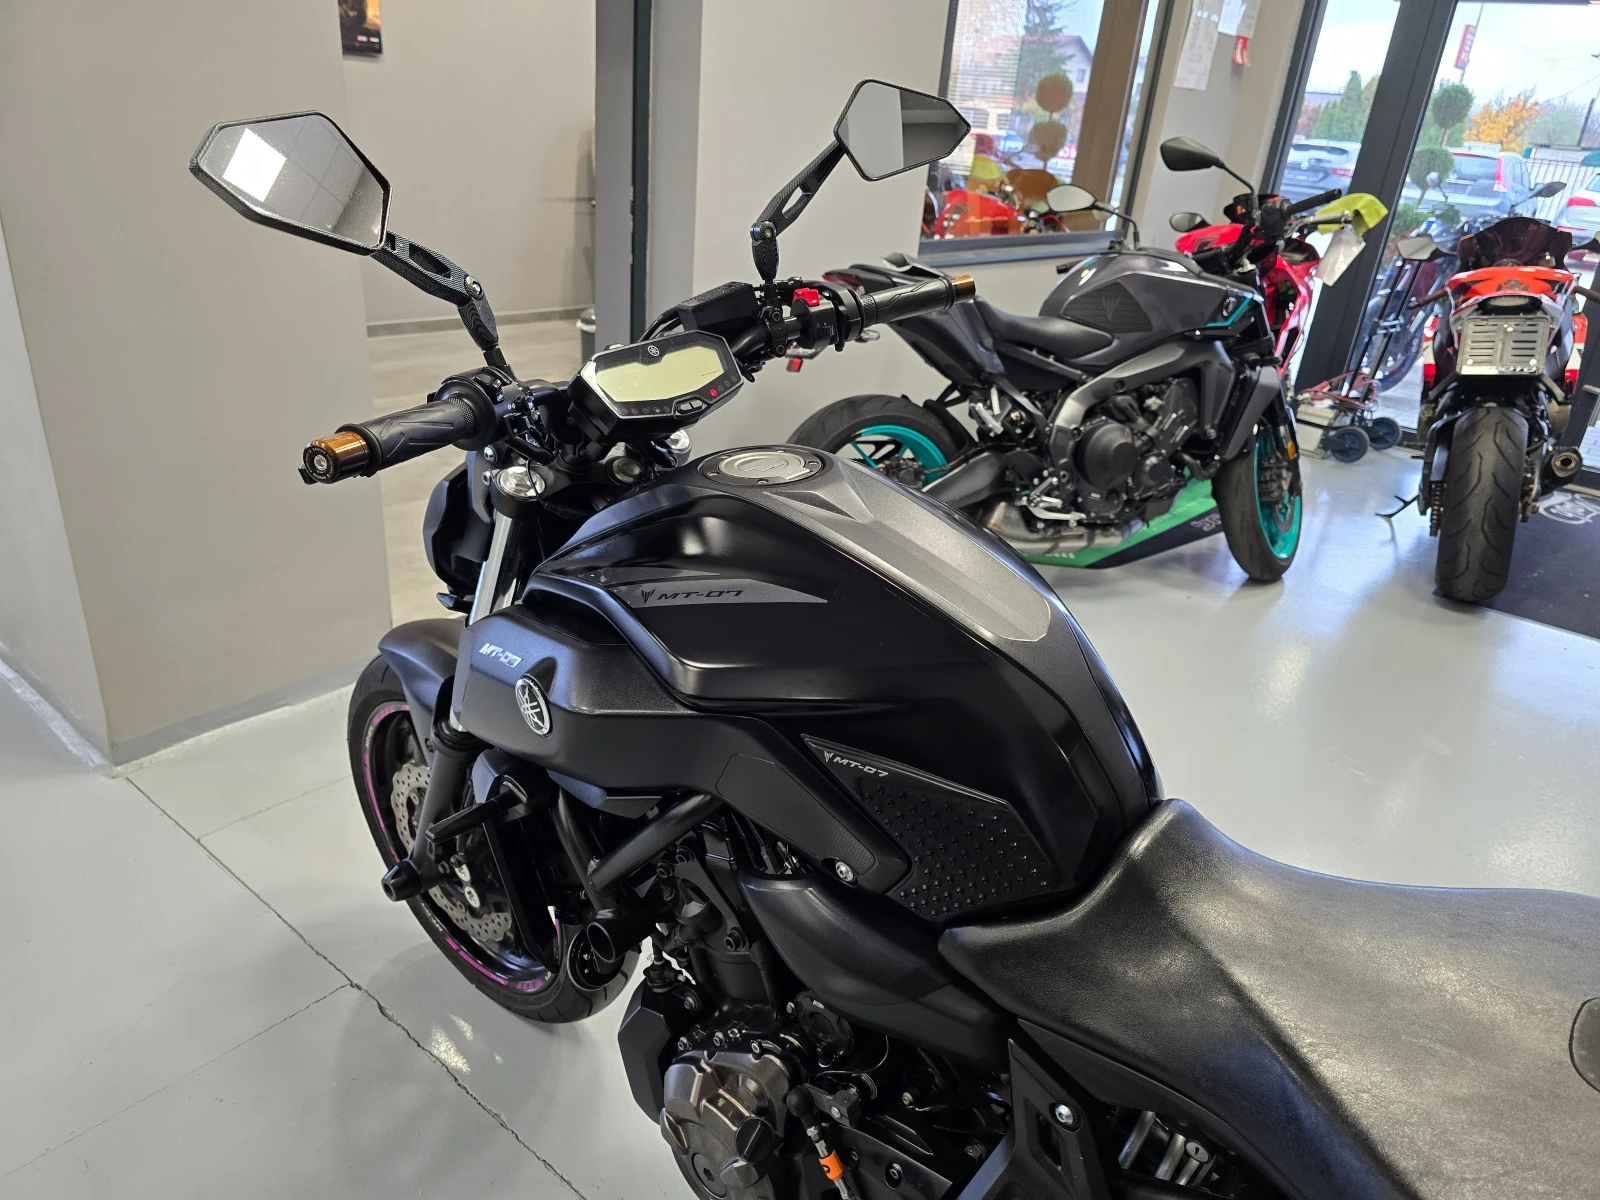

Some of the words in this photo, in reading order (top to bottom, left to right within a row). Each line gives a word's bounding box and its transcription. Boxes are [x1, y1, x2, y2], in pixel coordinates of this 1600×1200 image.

[657, 590, 743, 600] MT-07
[479, 643, 523, 668] MT-07
[833, 756, 889, 777] MT-07
